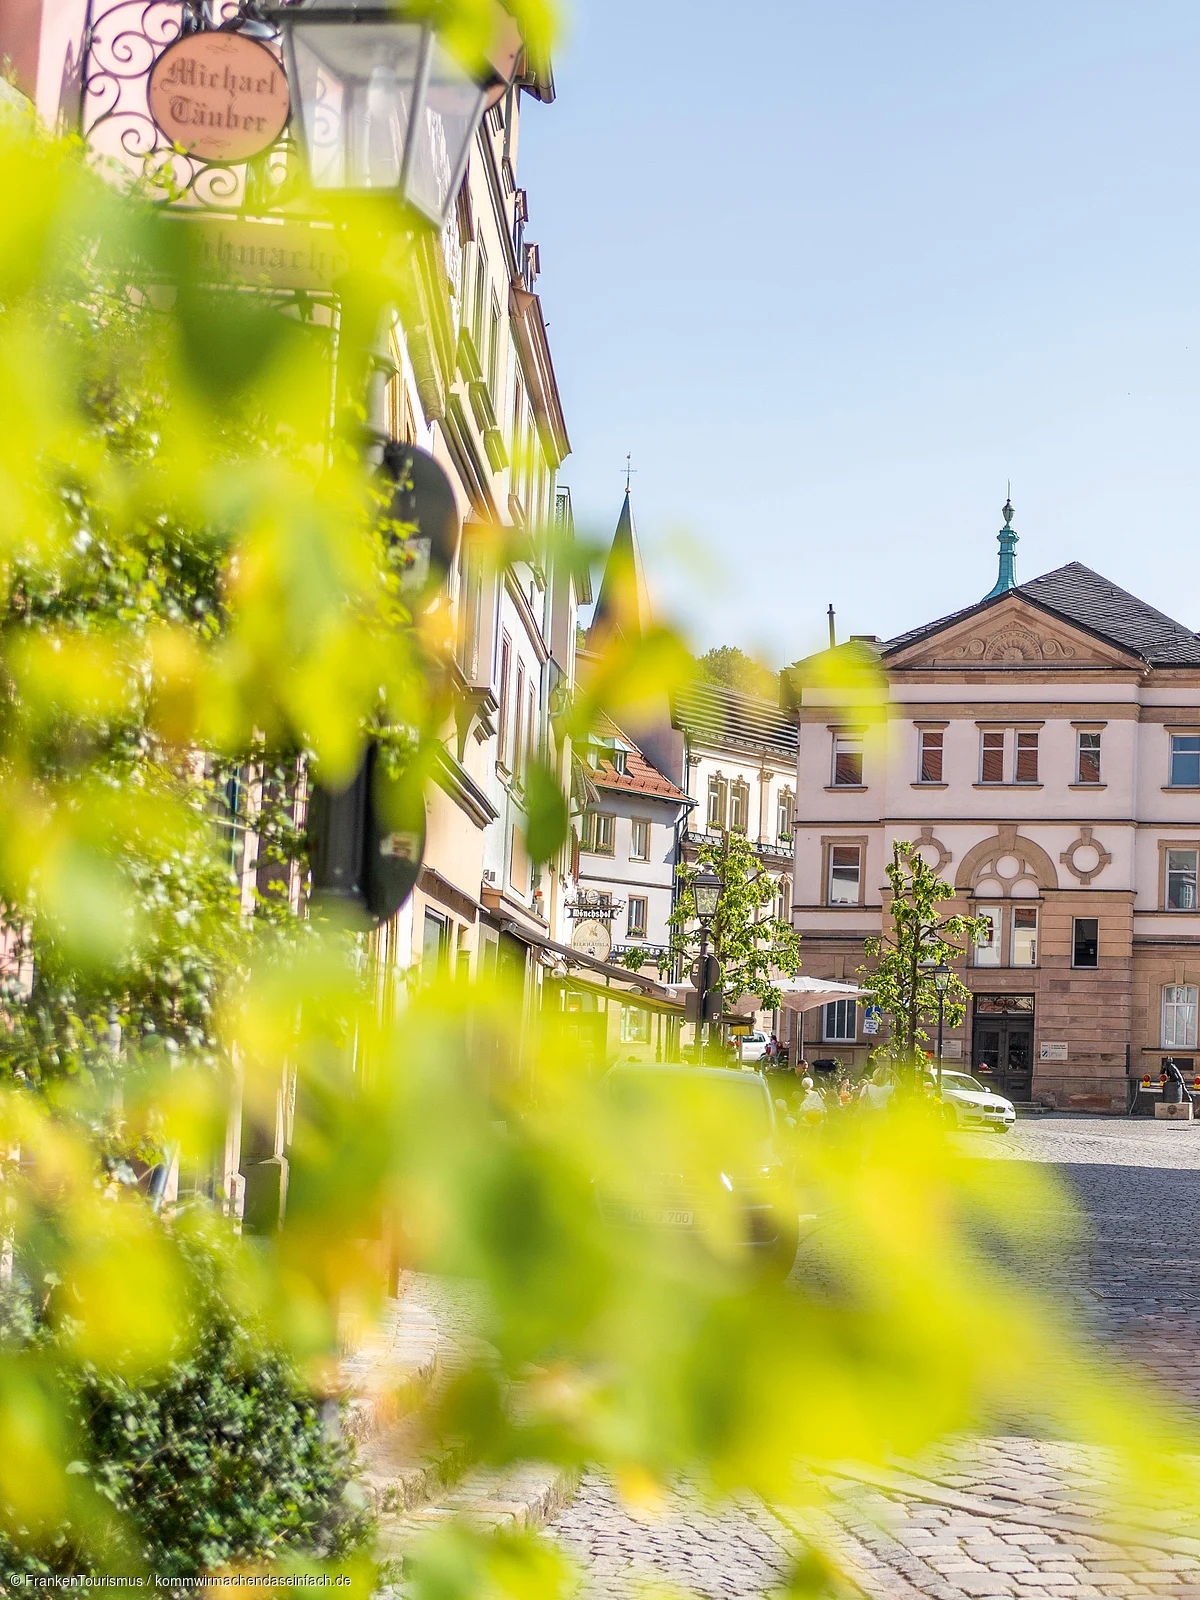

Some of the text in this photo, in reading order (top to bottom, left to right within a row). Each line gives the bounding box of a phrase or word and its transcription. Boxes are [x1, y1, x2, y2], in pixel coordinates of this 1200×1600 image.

[160, 57, 277, 99] Michael
[169, 95, 268, 133] Täuber
[573, 908, 611, 918] Mönchshof
[668, 1212, 689, 1224] 700
